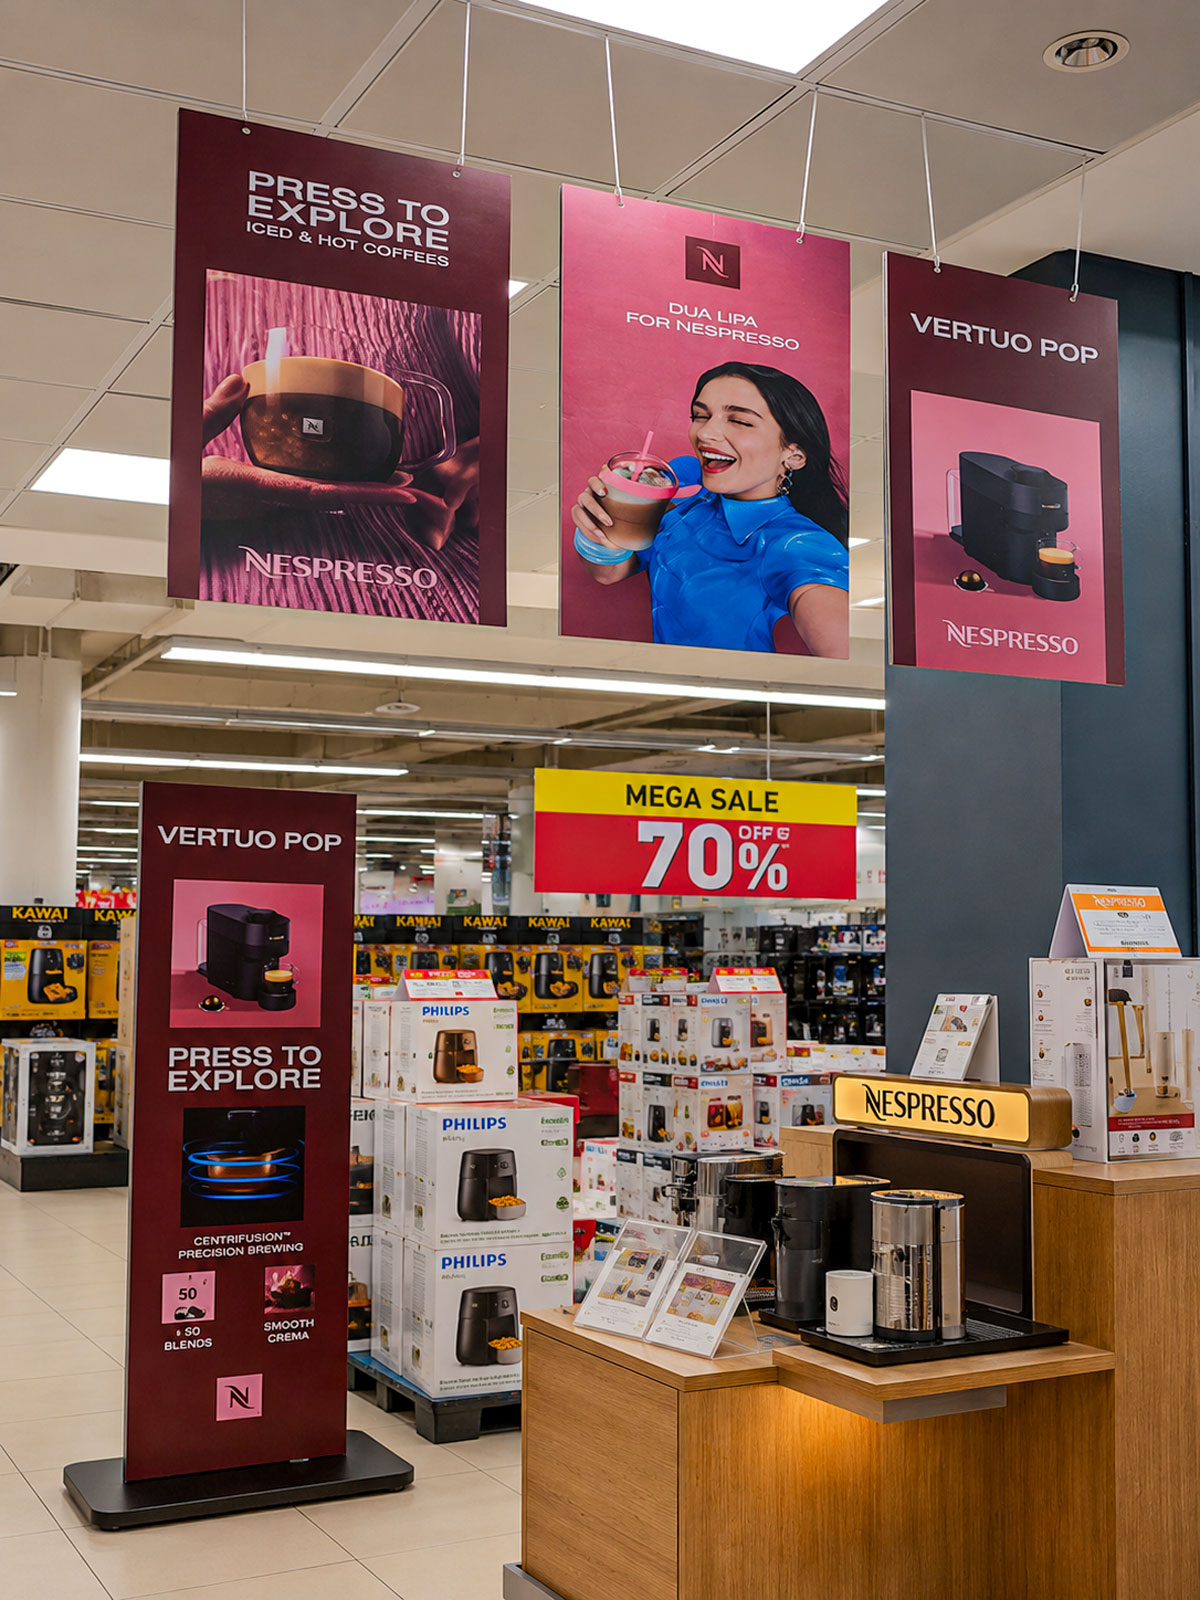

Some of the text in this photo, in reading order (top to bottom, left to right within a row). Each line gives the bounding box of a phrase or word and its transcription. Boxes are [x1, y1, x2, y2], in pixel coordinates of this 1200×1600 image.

[249, 170, 449, 226] PRESS TO
[248, 194, 449, 251] EXPLORE
[246, 221, 449, 267] ICED & HOT COFFEES
[669, 302, 758, 328] DUA LIPA
[626, 312, 800, 351] FOR NESPRESSO
[910, 312, 1099, 364] VERTUO POP
[238, 545, 438, 589] NESPRESSO
[942, 619, 1079, 655] NESPRESSO
[626, 784, 779, 813] MEGA SALE
[157, 825, 342, 852] VERTUO POP
[739, 825, 773, 840] OFF
[637, 820, 789, 892] 70%
[12, 907, 68, 920] KAWAI
[95, 909, 136, 922] KAW
[463, 916, 507, 927] KAWAI
[528, 917, 570, 928] KAWAI
[422, 1006, 470, 1017] PHILIPS
[168, 1045, 322, 1068] PRESS TO
[168, 1068, 321, 1092] EXPLORE
[862, 1083, 995, 1129] NESPRESSO
[442, 1117, 507, 1131] PHILIPS
[178, 1242, 304, 1260] PRECISION BREWING
[441, 1253, 507, 1270] PHILIPS
[178, 1287, 198, 1301] 50
[264, 1319, 315, 1332] SMOOTH
[164, 1338, 213, 1351] BLENDS
[267, 1331, 310, 1344] CREMA
